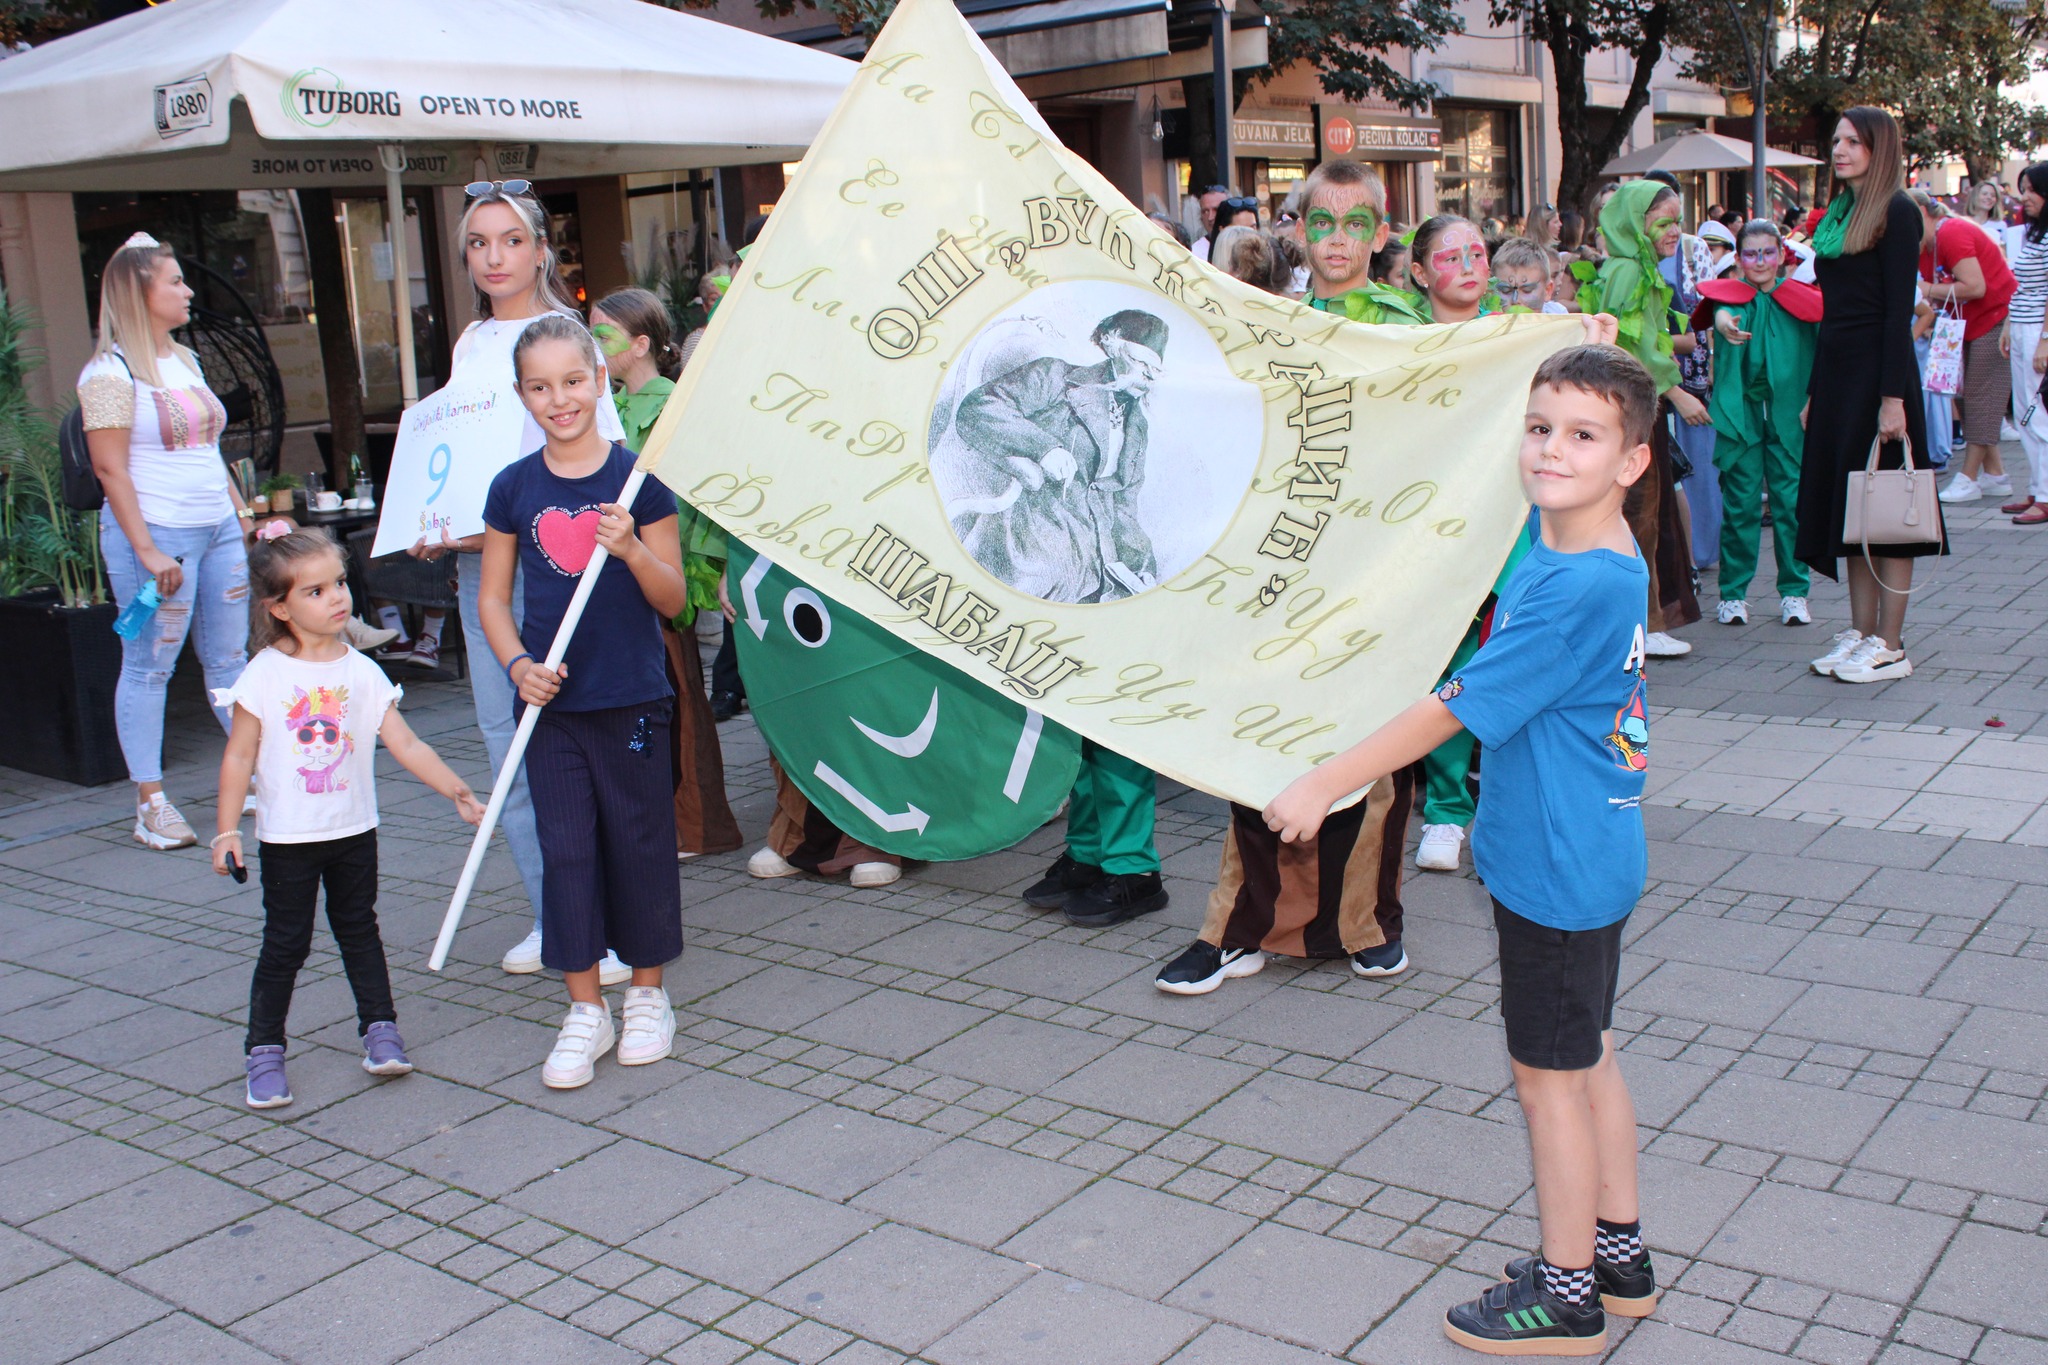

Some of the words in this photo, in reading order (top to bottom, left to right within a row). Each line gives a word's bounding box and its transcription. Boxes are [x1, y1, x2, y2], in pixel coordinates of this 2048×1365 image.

[170, 92, 207, 118] 1880
[298, 87, 401, 117] TUBORG
[419, 95, 481, 116] OPEN
[483, 98, 515, 117] TO
[521, 99, 583, 119] MORE
[1284, 127, 1312, 143] JELA
[1359, 131, 1394, 146] PECIVA
[867, 234, 985, 360] ОШ
[426, 442, 453, 506] 9
[419, 510, 452, 533] Šabac
[847, 522, 1083, 700] ШАБАЦ
